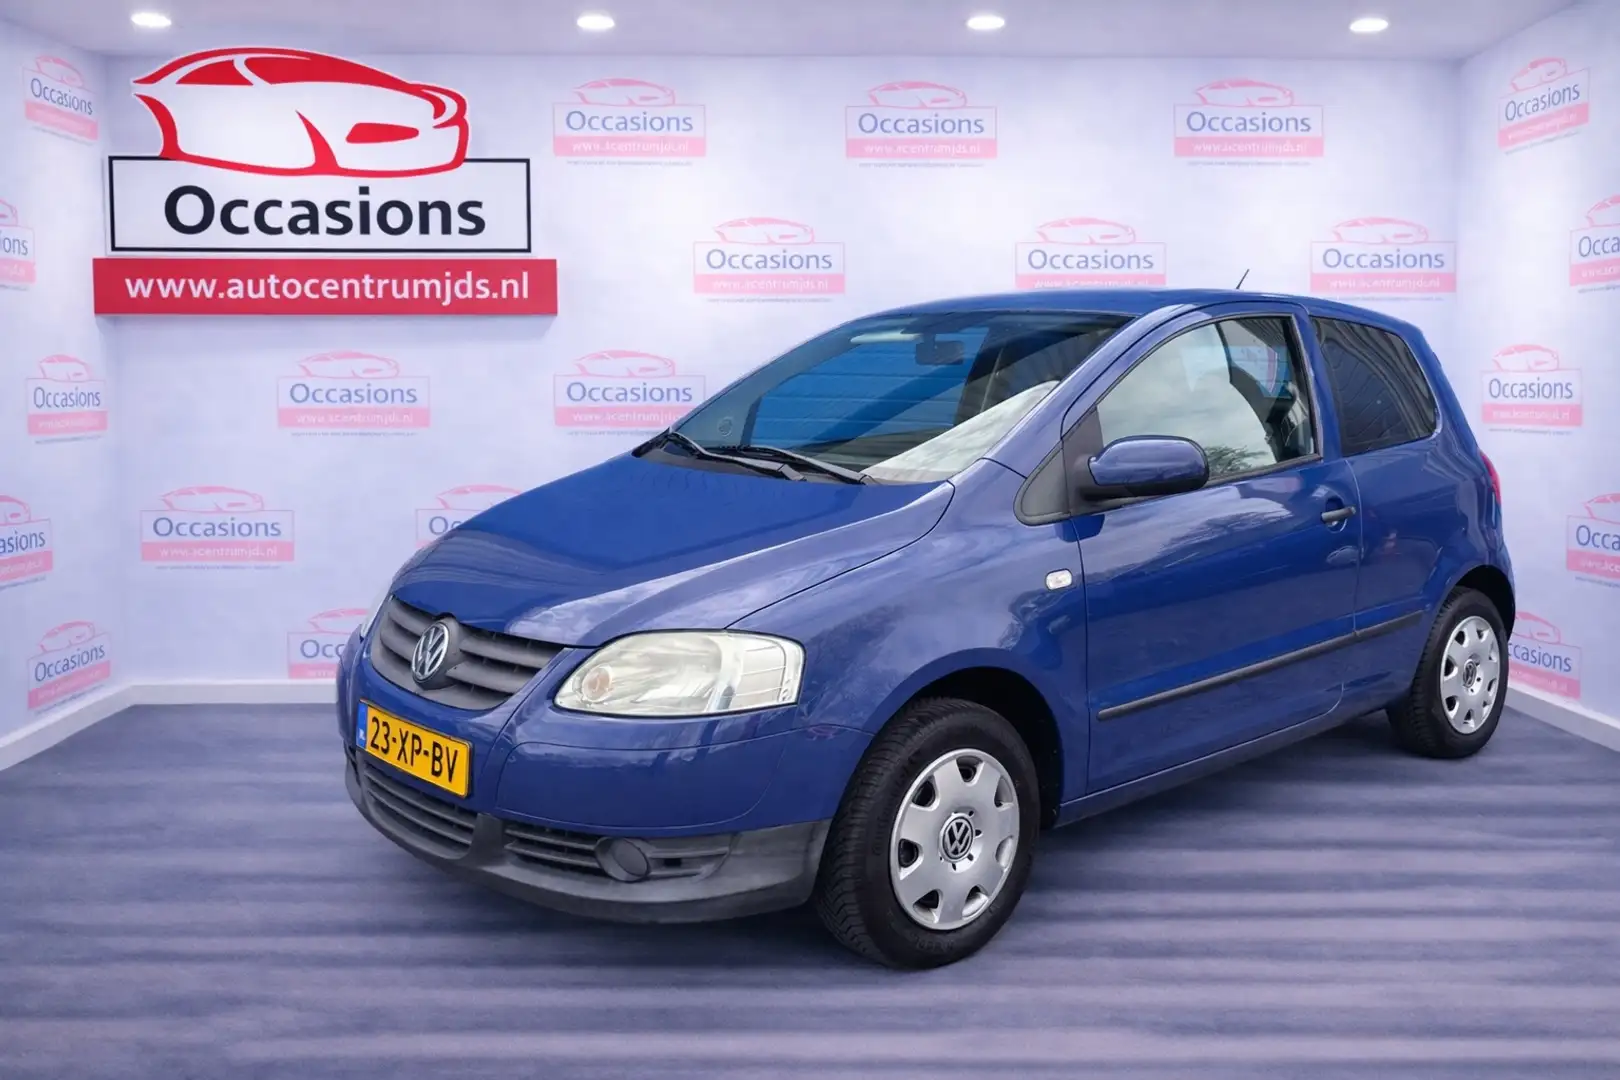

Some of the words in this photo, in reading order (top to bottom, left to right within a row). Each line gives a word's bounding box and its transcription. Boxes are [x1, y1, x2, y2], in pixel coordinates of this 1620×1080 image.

[30, 77, 93, 116] Occasions
[1505, 82, 1580, 122] Occasions
[565, 110, 694, 132] Occasions
[857, 112, 985, 133] Occasions
[1186, 111, 1312, 133] Occasions
[164, 186, 486, 237] Occasions
[706, 248, 833, 270] Occasions
[1027, 248, 1154, 270] Occasions
[1322, 247, 1445, 269] Occasions
[125, 272, 530, 305] www.autocentrumjds.nl
[33, 385, 101, 410] Occasions
[289, 382, 418, 404] Occasions
[566, 381, 693, 403] Occasions
[1488, 376, 1574, 400] Occasions
[152, 516, 282, 538] Occasions
[0, 529, 46, 556] asions
[34, 643, 106, 684] Occasions
[1508, 641, 1573, 673] ccasions
[370, 716, 458, 784] 23-XP-BV
